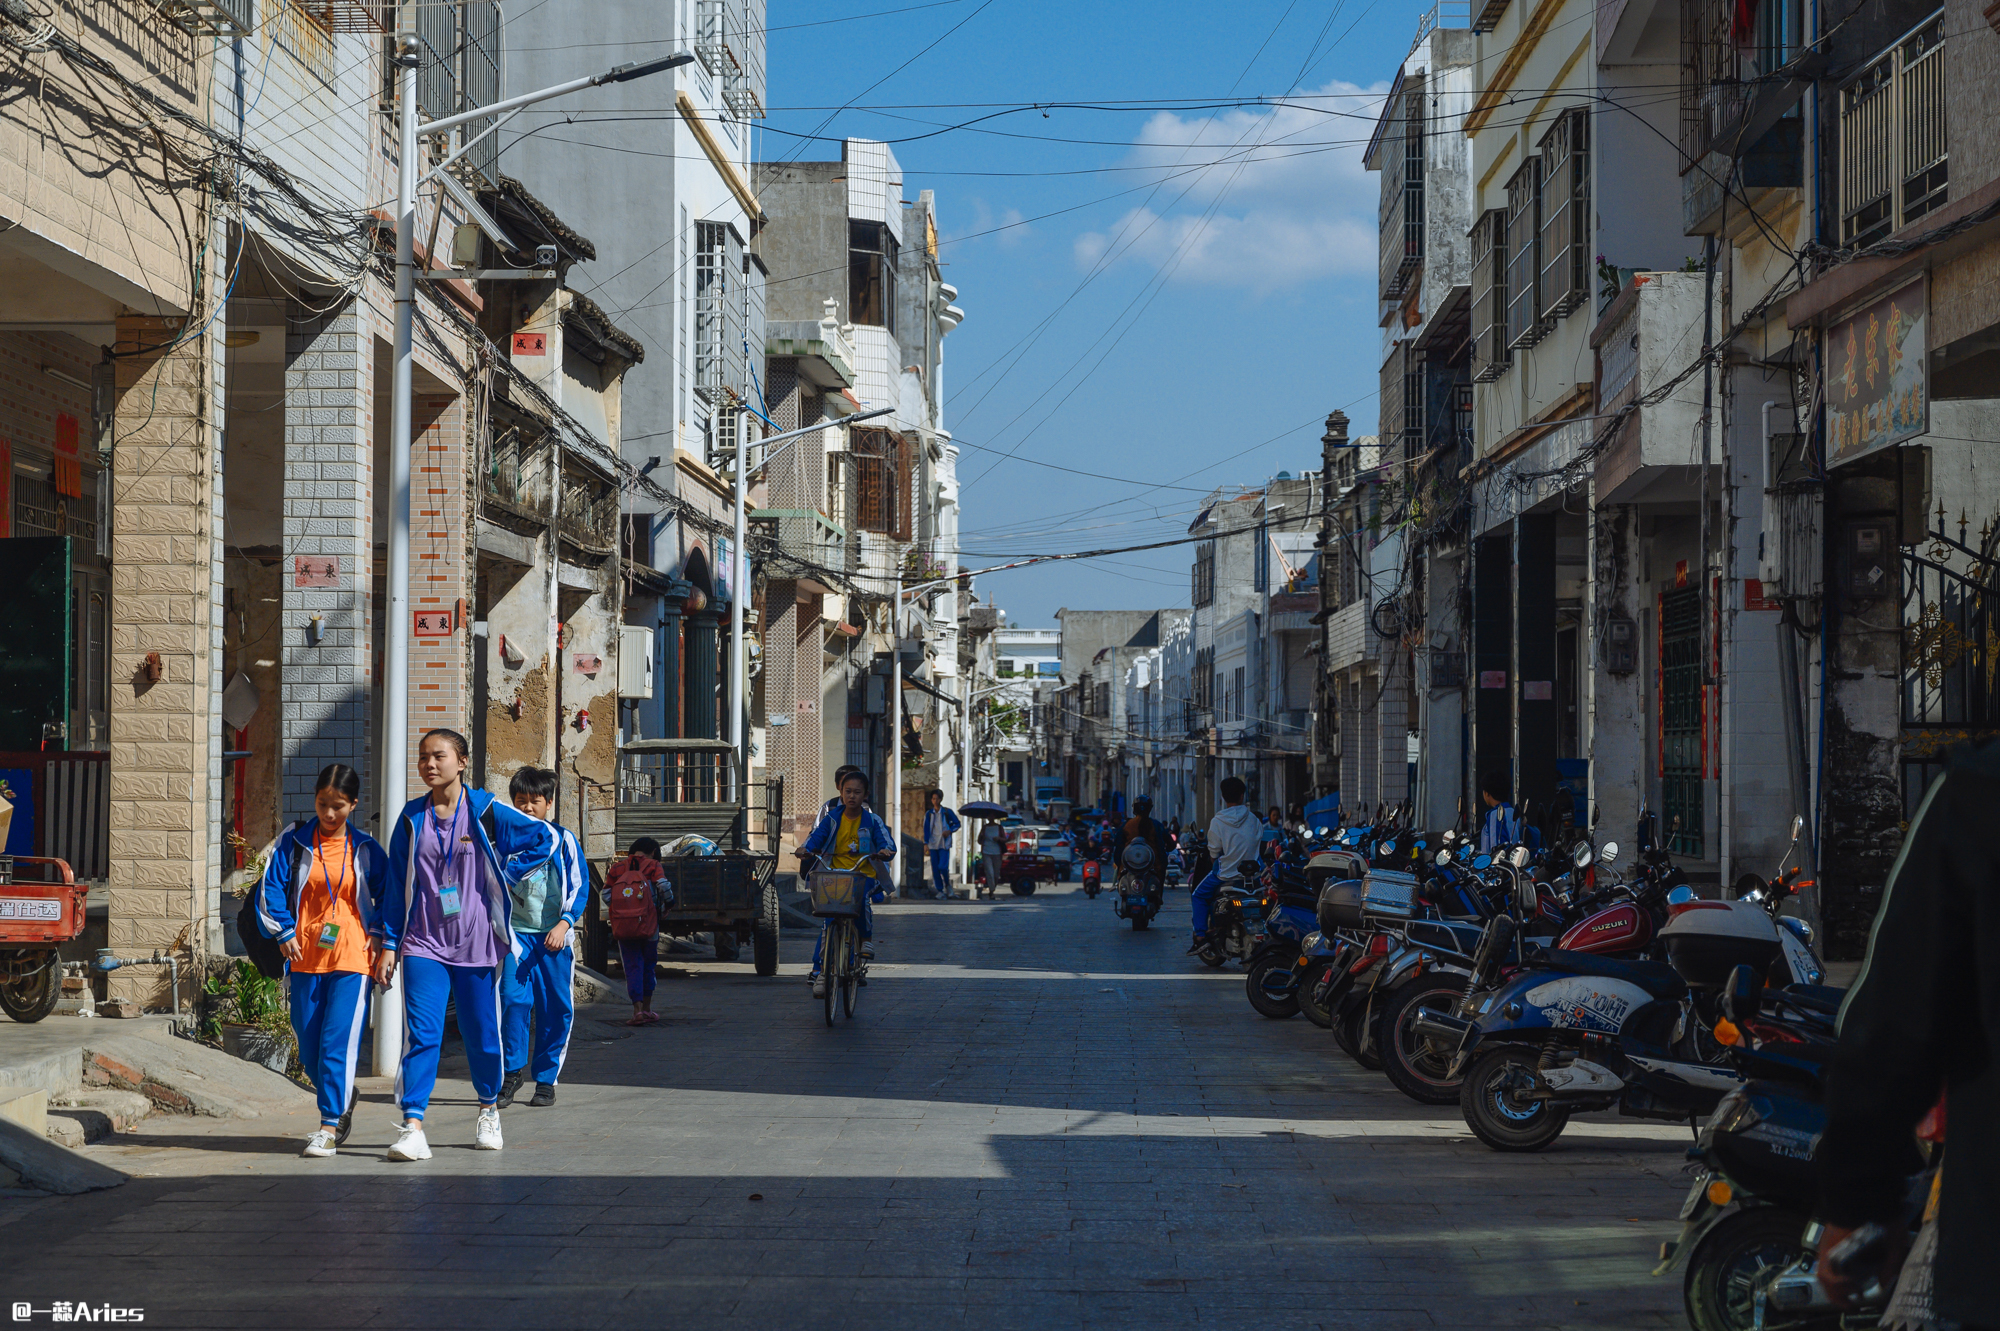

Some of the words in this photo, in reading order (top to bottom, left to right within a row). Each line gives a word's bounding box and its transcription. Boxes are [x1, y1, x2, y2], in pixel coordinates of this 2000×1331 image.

[0, 900, 58, 920] 瑞仕达
[1591, 919, 1628, 932] SUZUKI
[1770, 1143, 1813, 1162] XL1200D
